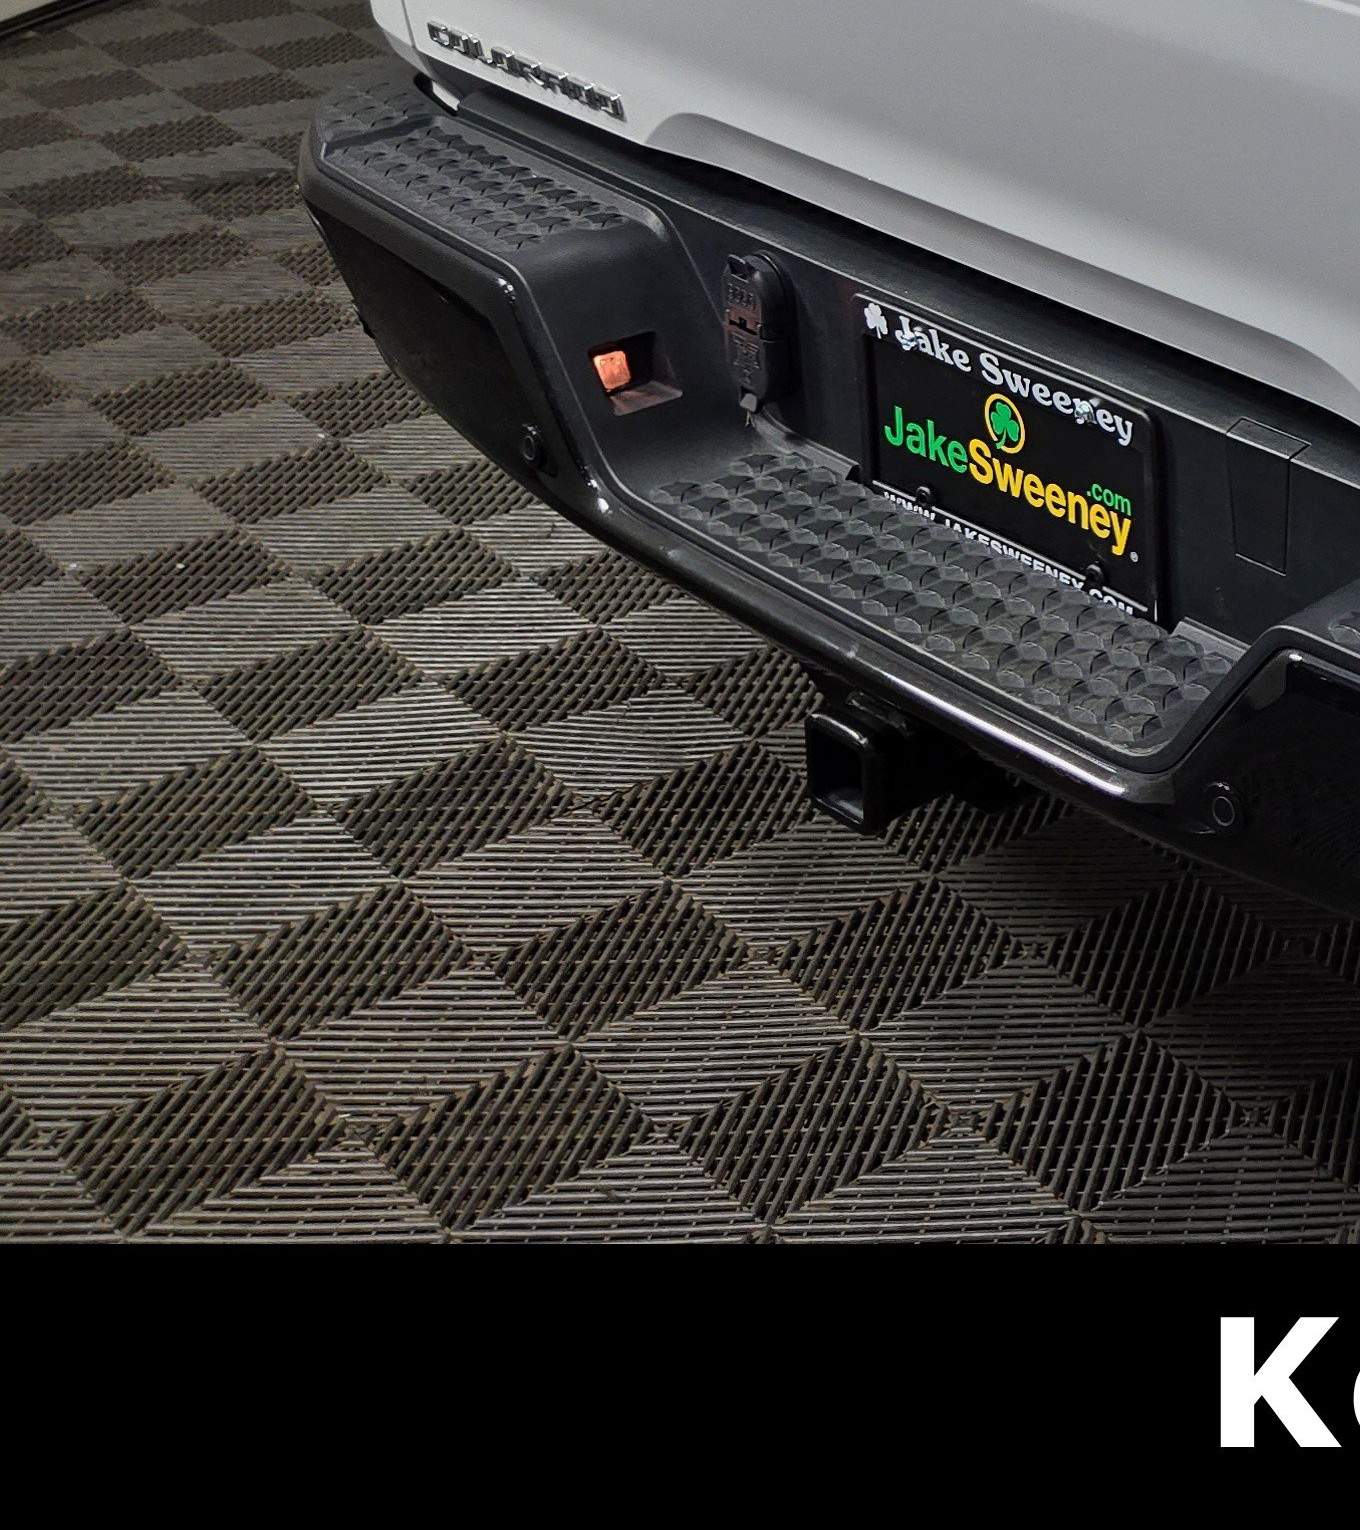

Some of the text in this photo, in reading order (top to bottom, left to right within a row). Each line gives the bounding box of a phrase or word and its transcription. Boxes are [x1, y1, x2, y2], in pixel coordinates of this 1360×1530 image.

[895, 314, 1134, 447] Jake Sweeney
[1086, 483, 1132, 517] .com
